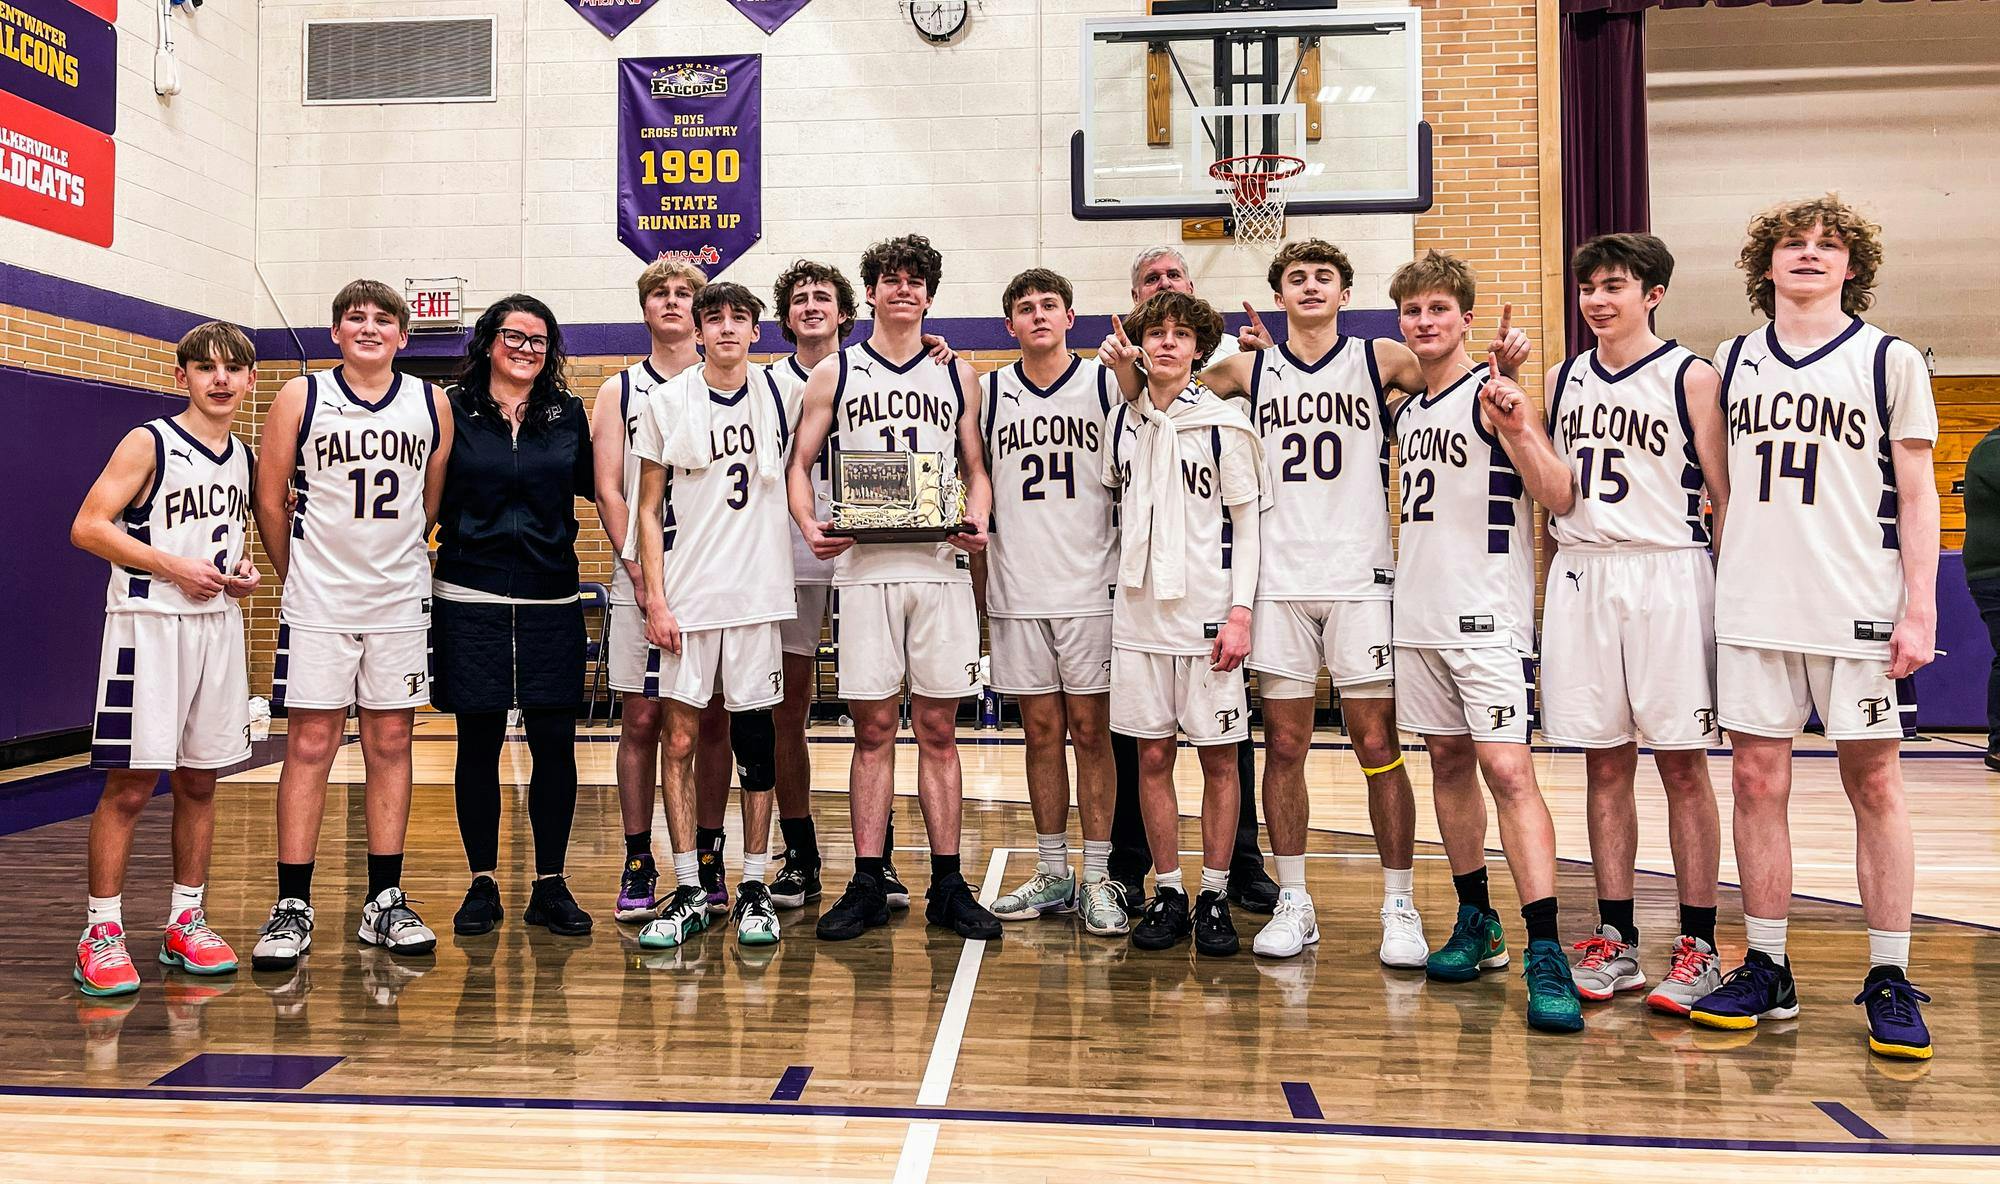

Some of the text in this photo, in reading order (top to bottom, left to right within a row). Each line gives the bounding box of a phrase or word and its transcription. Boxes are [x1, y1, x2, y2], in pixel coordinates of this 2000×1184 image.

[652, 63, 727, 77] PENTWATER
[652, 77, 727, 96] FALCONS
[641, 126, 738, 138] CROSS COUNTRY
[674, 115, 704, 125] BOYS
[0, 126, 69, 168] LKERVILLE
[639, 149, 740, 185] 1990
[638, 213, 741, 230] RUNNER UP
[661, 195, 718, 211] STATE
[417, 291, 451, 318] EXIT
[846, 390, 953, 433] FALCONS
[1258, 391, 1371, 439] FALCONS
[1561, 402, 1669, 457] FALCONS
[1730, 391, 1867, 450] FALCONS
[314, 428, 426, 472] FALCONS
[997, 414, 1099, 461] FALCONS
[1282, 430, 1342, 482] 20
[1398, 426, 1468, 468] LCONS
[348, 467, 400, 519] 12
[726, 462, 750, 511] 3
[1020, 451, 1076, 502] 24
[1576, 446, 1629, 503] 15
[1755, 440, 1819, 505] 14
